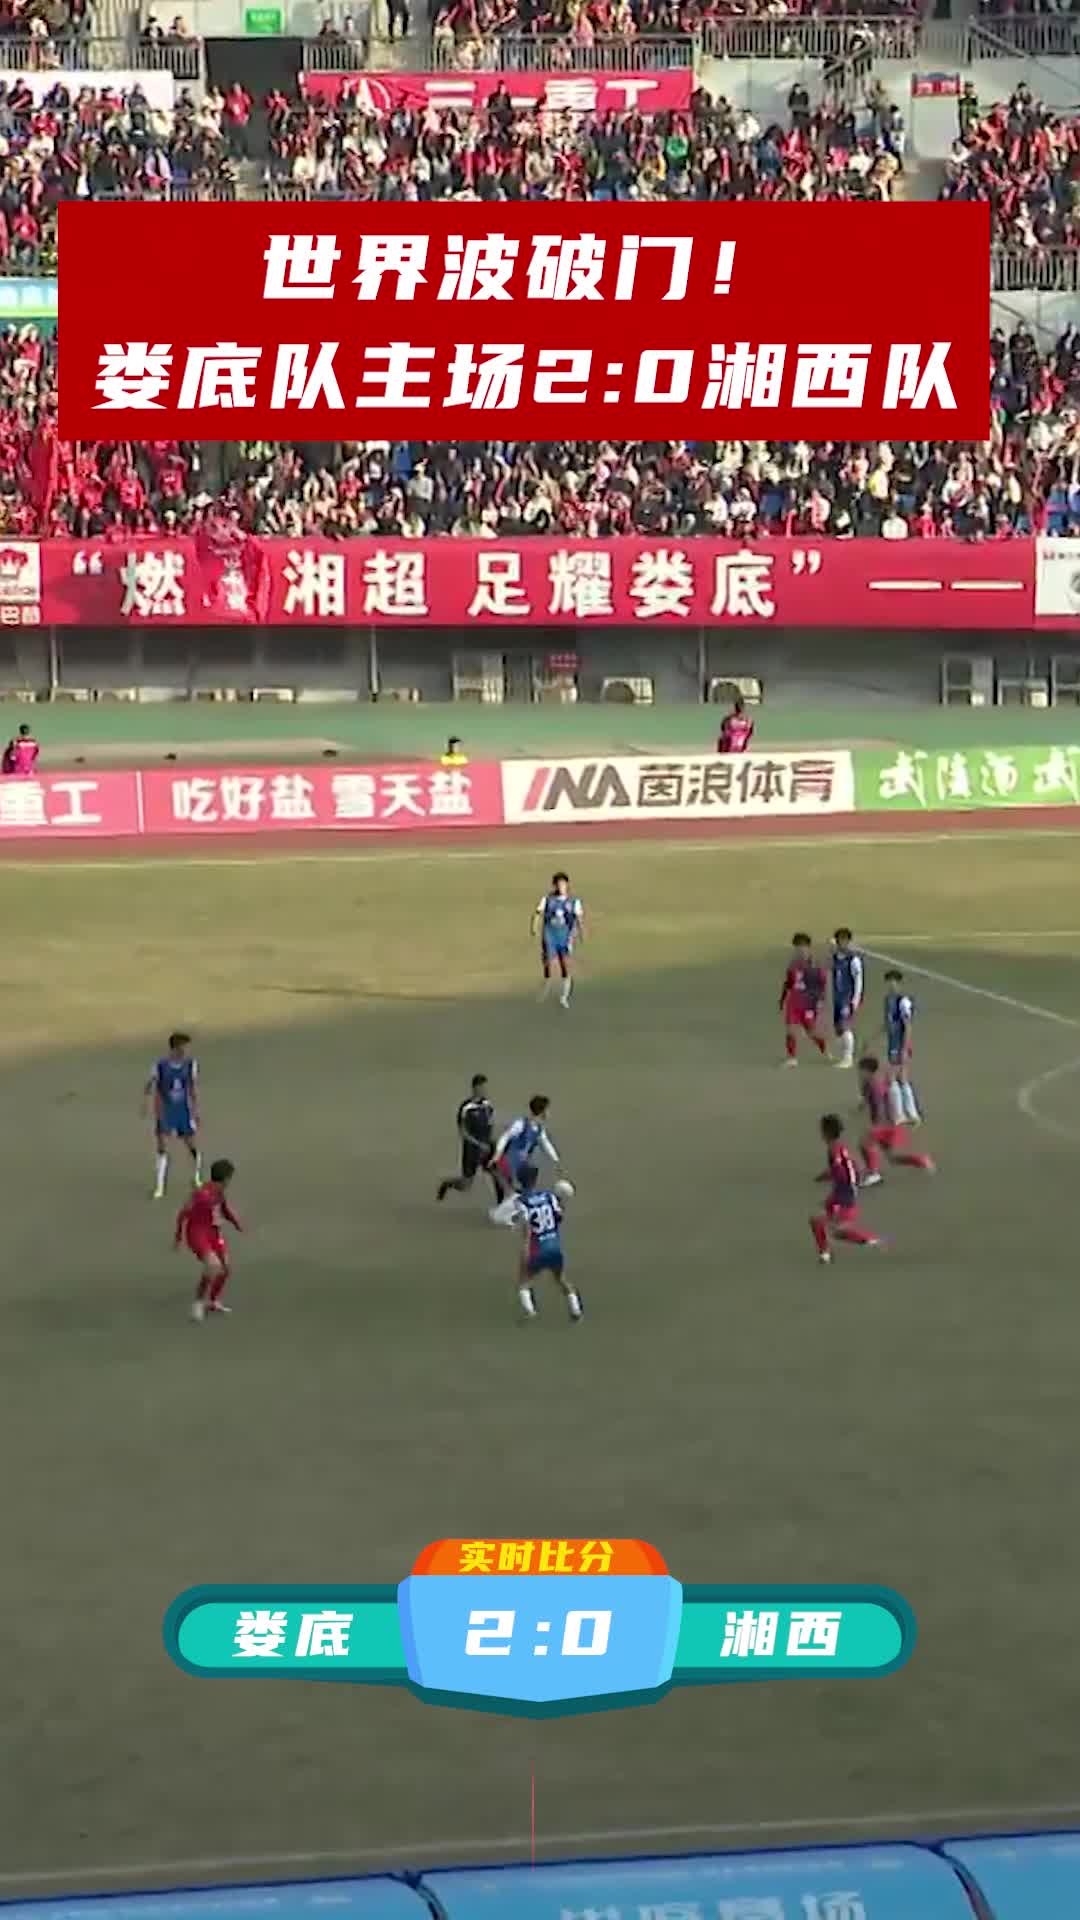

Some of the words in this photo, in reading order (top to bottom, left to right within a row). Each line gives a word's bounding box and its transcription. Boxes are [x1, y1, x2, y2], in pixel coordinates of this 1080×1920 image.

[172, 773, 315, 822] 吃好盐
[331, 771, 474, 819] 雪天盐
[636, 759, 835, 806] 茵浪体育
[528, 1203, 555, 1234] 38
